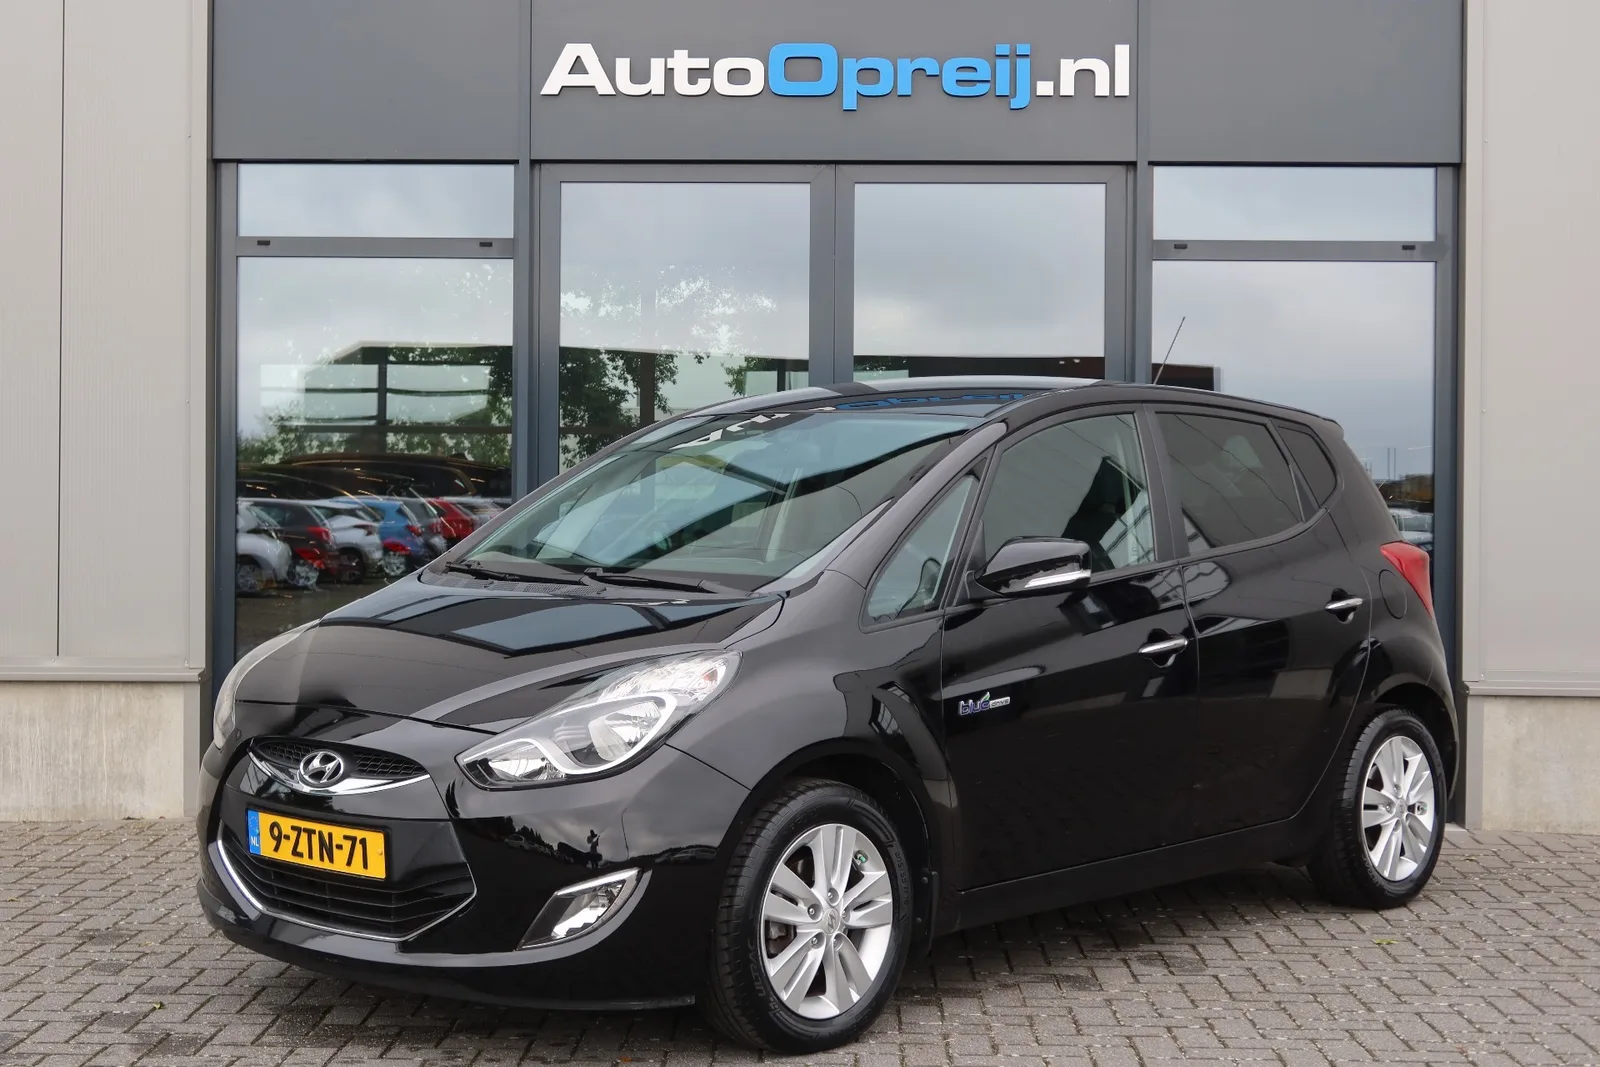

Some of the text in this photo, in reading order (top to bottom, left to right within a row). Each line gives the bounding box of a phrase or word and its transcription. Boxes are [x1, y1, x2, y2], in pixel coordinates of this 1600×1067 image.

[540, 42, 1130, 111] AutoOpreij.nl
[958, 698, 989, 715] blue
[250, 836, 259, 847] NL
[269, 821, 368, 870] 9-ZTN-71
